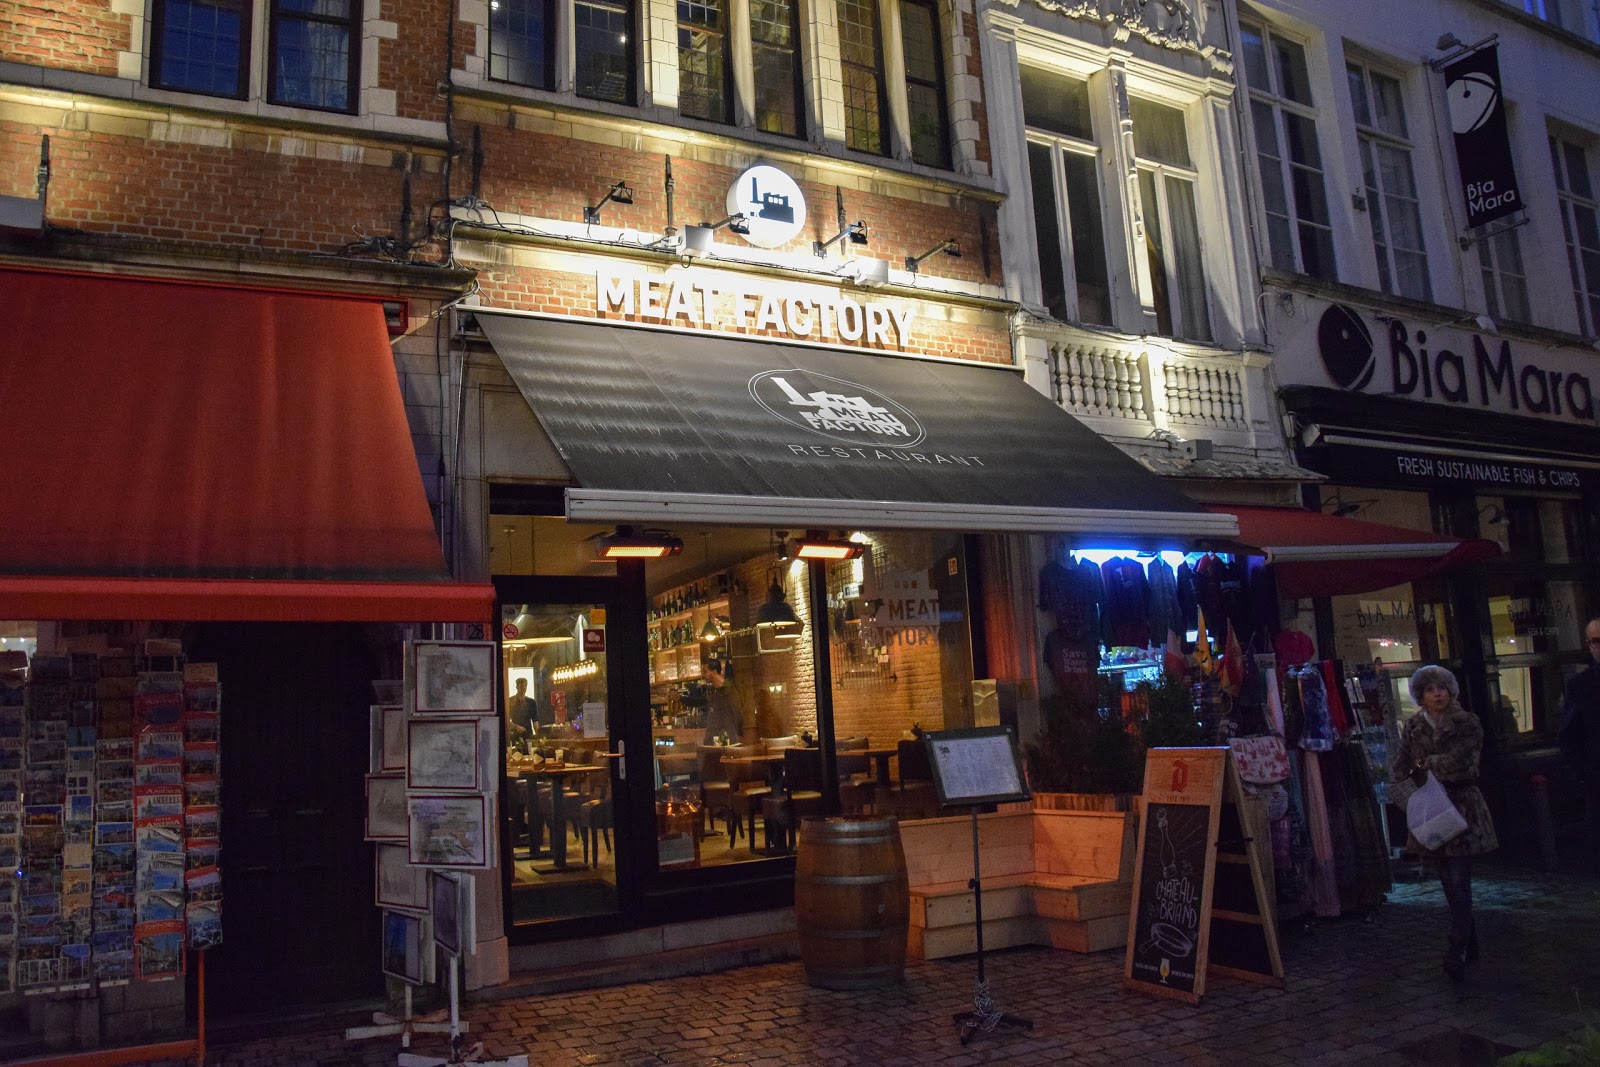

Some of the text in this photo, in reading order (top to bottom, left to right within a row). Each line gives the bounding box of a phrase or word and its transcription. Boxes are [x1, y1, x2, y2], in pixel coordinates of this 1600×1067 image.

[1467, 181, 1494, 200] Bia
[1469, 190, 1516, 216] Mara
[596, 268, 914, 347] MEAT FACTORY
[1390, 320, 1594, 419] Bia Mara
[832, 406, 898, 424] MEAT
[806, 418, 911, 437] FACTORY
[788, 444, 985, 466] RESTAURANT
[1397, 456, 1580, 487] FRESH SUSTAINABLE FISH & CHIPS
[888, 598, 939, 621] MEAT
[1357, 601, 1385, 628] BIA
[468, 624, 484, 640] 28
[864, 623, 940, 647] FACTORY
[1062, 648, 1087, 658] Save
[1159, 899, 1197, 929] BRIAND
